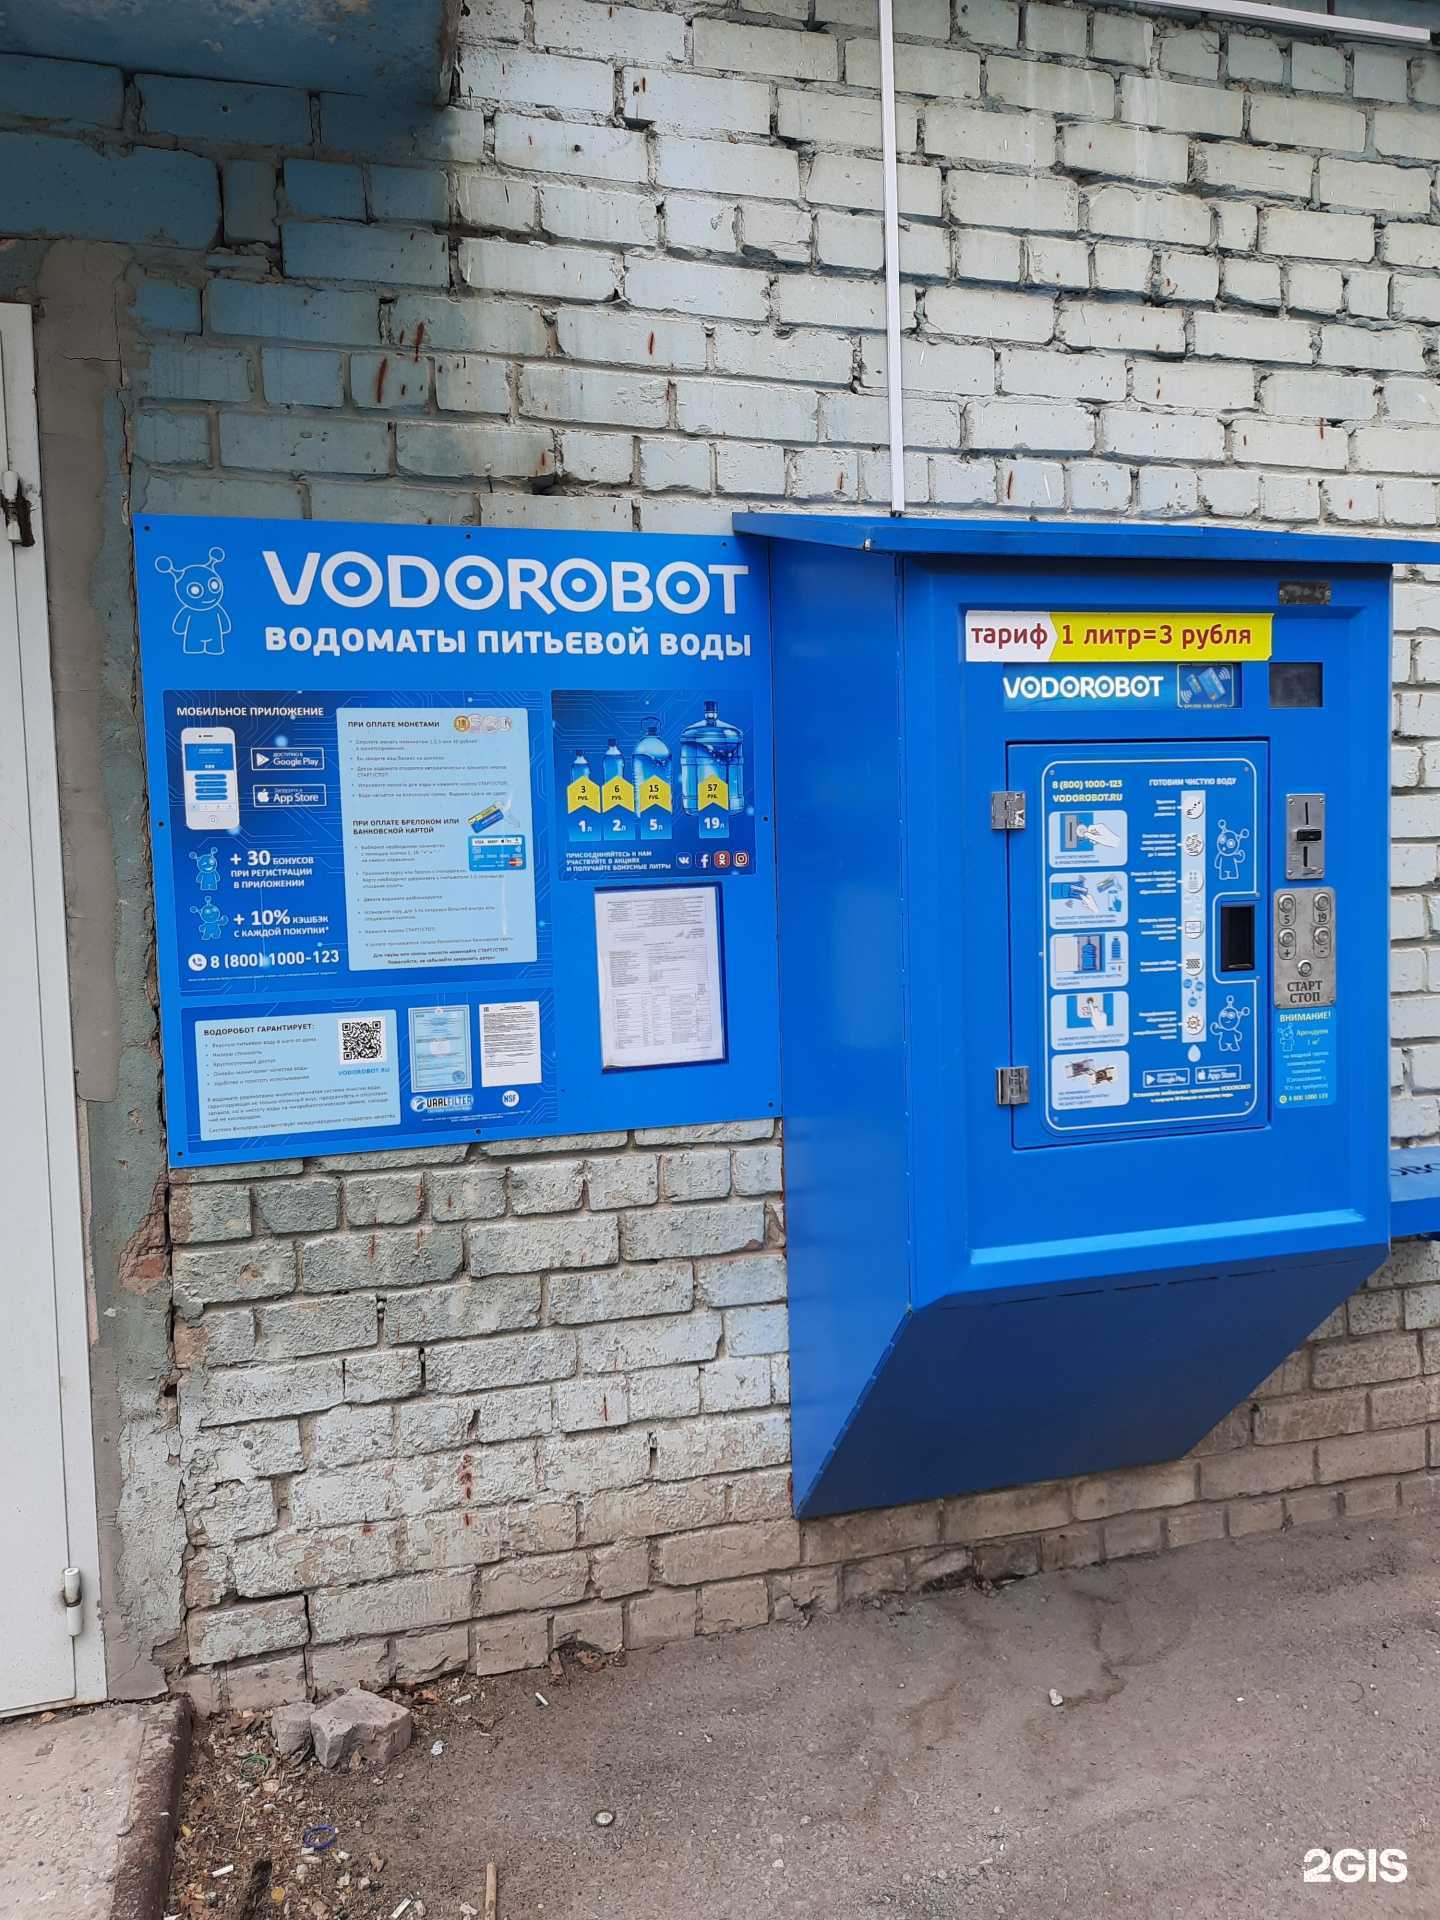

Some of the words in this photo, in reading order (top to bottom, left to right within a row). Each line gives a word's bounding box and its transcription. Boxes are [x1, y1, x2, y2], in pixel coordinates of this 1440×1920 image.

[262, 550, 749, 615] VODOROBOT
[971, 623, 1048, 649] тариф
[1062, 625, 1073, 644] 1
[1182, 624, 1251, 650] рубля
[265, 626, 466, 656] ВОДОМАТЫ
[477, 626, 649, 656] ПИТЬЕВОЙ
[660, 633, 751, 661] ВОДЫ
[1003, 675, 1164, 699] VODOROBOT
[176, 706, 247, 717] МОБИЛЬНОЕ
[250, 706, 324, 717] ПРИЛОЖЕНИЕ
[273, 757, 302, 767] Google
[302, 757, 319, 767] Play
[614, 785, 620, 793] 6
[649, 784, 659, 792] 15
[707, 784, 718, 792] 57
[273, 793, 294, 804] App
[294, 792, 319, 802] Store
[1053, 793, 1123, 803] VODOROBOT.RU
[370, 819, 399, 827] ОПЛАТЕ
[401, 818, 442, 826] БРЕЛОКОМ
[353, 828, 403, 836] БАНКОВСКОЙ
[247, 850, 271, 866] 30
[273, 856, 315, 865] БОНУСОВ
[231, 870, 249, 878] ПРИ
[251, 868, 313, 878] РЕГИСТРАЦИИ
[233, 881, 239, 889] В
[241, 880, 305, 889] ПРИЛОЖЕНИИ
[251, 909, 290, 926] 10%
[292, 915, 328, 924] КЭШБЭК
[1284, 915, 1290, 924] 5
[1317, 912, 1327, 923] 19
[234, 930, 240, 938] С
[241, 927, 282, 938] КАЖДОЙ
[210, 955, 220, 968] 8
[224, 953, 263, 969] (800)
[268, 950, 340, 965] 1000-123
[1287, 980, 1322, 992] СТАРТ
[1289, 991, 1320, 1003] СТОП
[1279, 1011, 1331, 1023] ВНИМАНИЕ!
[203, 1026, 255, 1037] ВОДОРОБОТ
